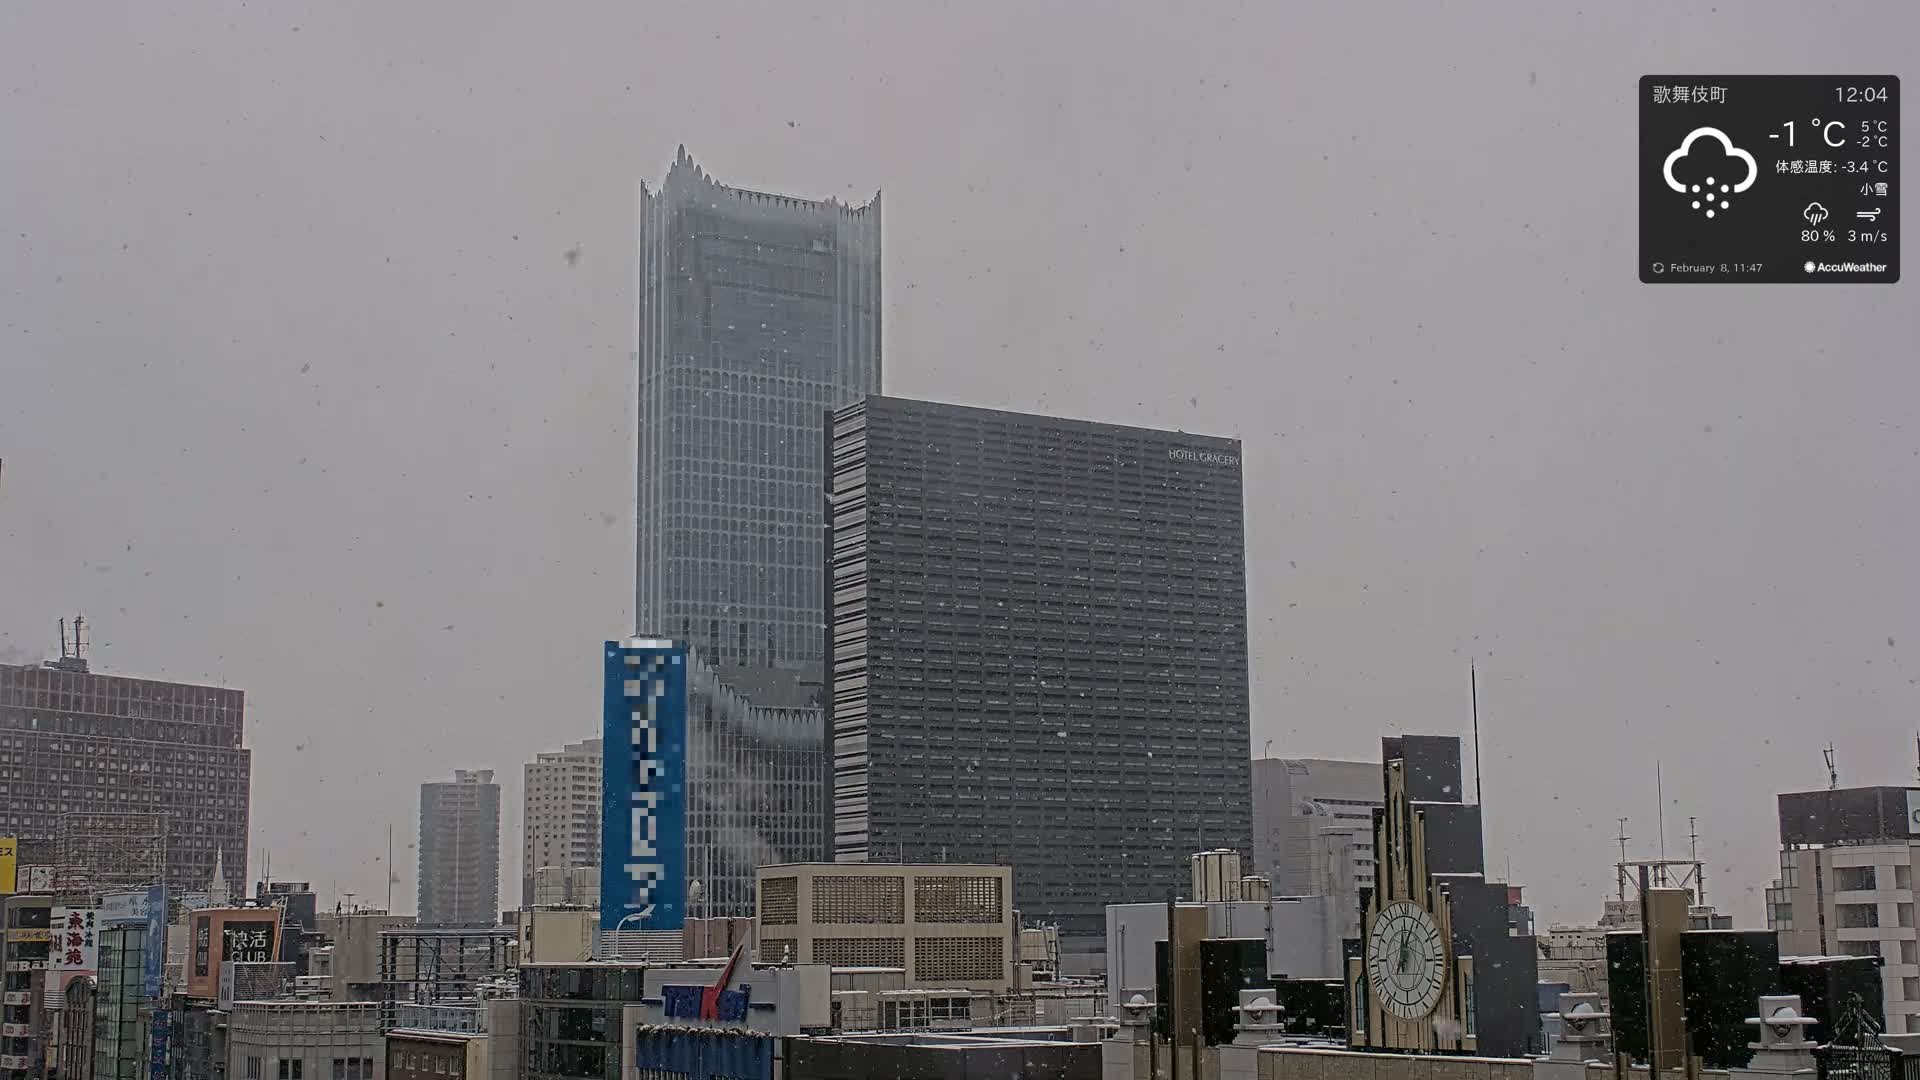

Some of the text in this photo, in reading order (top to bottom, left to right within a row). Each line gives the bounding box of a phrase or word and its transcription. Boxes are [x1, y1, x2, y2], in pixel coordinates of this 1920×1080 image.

[1168, 449, 1240, 465] HOTEL GRACERY
[65, 911, 84, 965] 東海苑
[231, 929, 267, 948] 快活
[231, 951, 266, 962] CLUB
